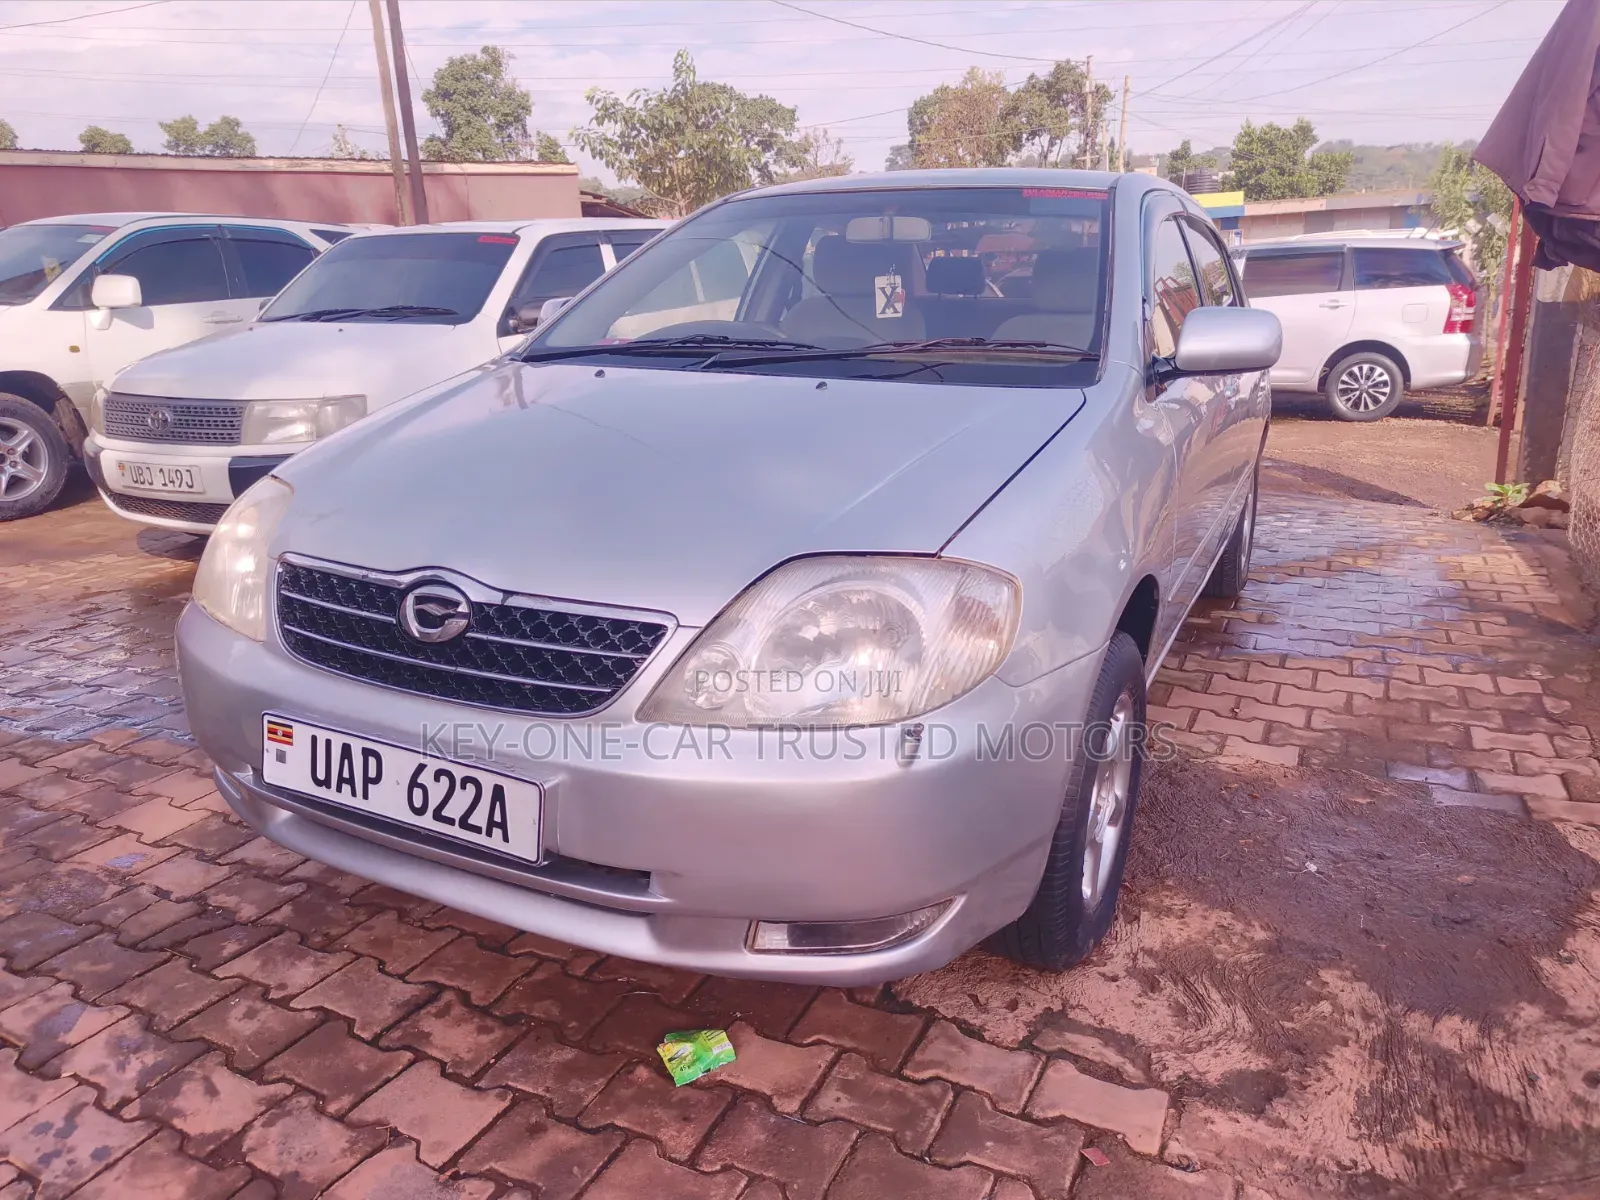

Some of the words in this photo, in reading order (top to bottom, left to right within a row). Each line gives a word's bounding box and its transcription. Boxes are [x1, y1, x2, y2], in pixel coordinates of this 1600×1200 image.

[129, 464, 154, 486] UBJ
[158, 467, 195, 489] 149J
[310, 734, 383, 801] UAP
[406, 762, 510, 844] 622A
